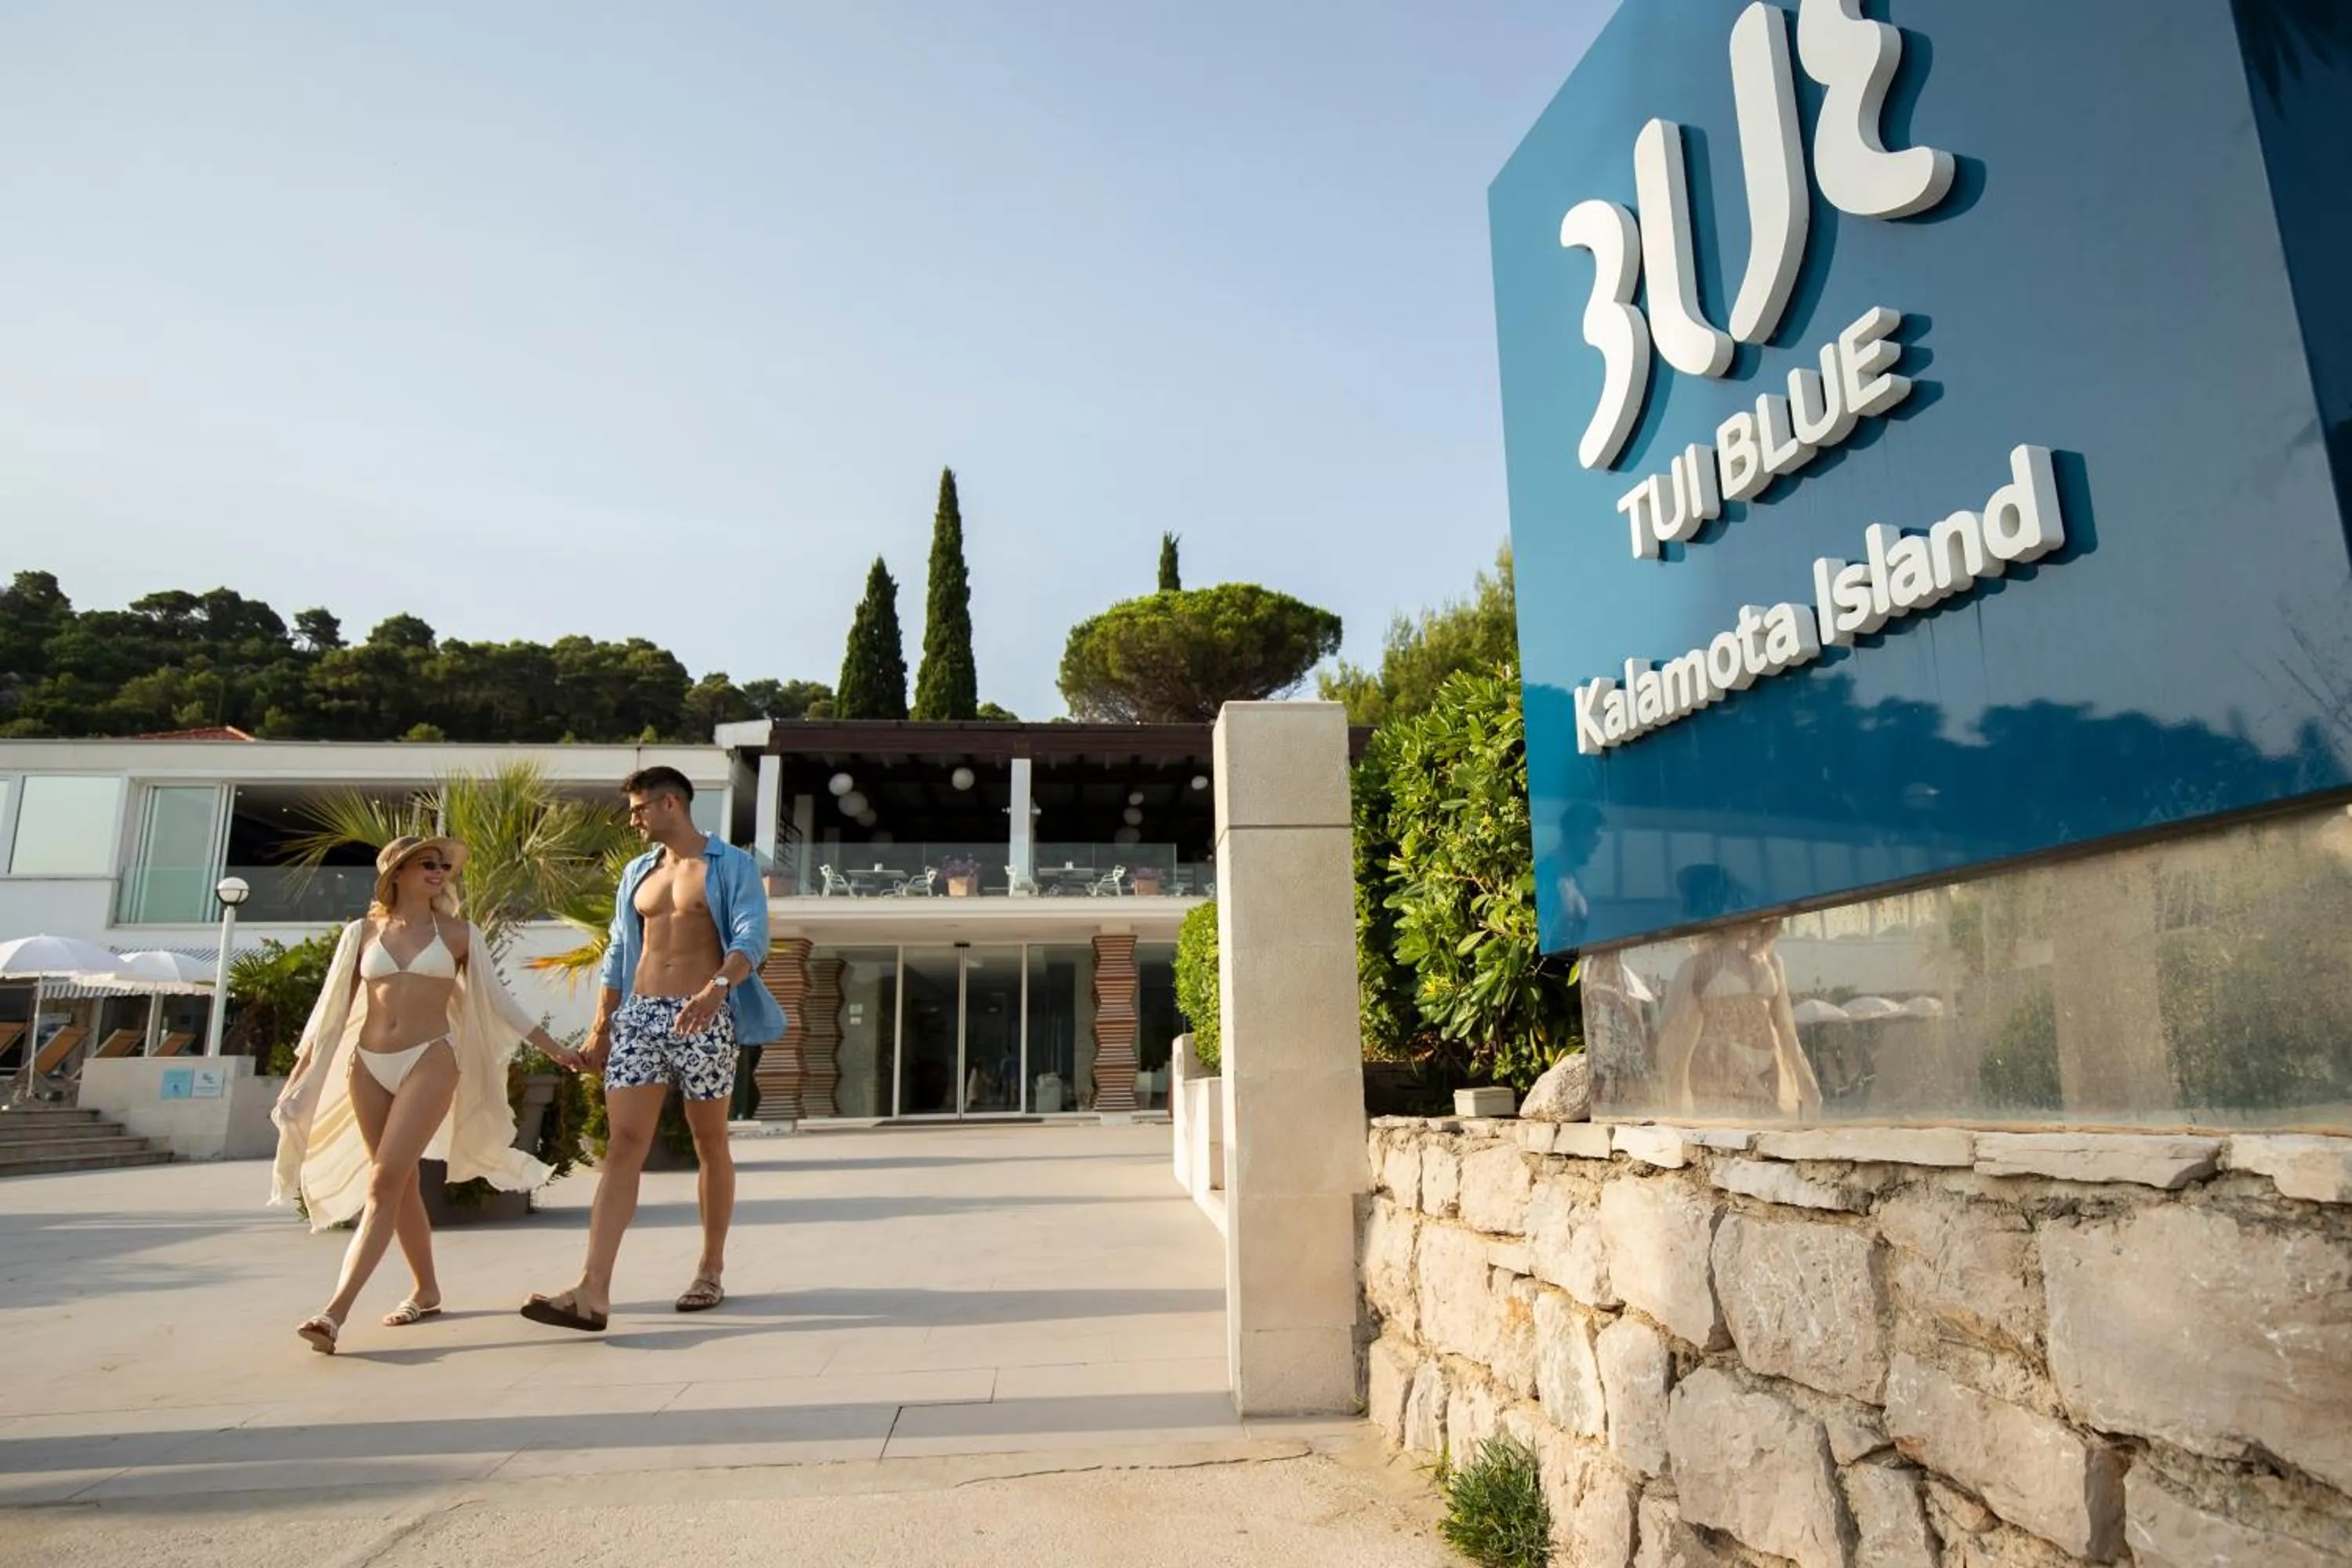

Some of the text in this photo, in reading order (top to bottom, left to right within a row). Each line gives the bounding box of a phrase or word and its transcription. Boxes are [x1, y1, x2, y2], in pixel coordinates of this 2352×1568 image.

[1617, 307, 1911, 559] TUI BLUE
[1574, 445, 2064, 754] Kalamota Island
